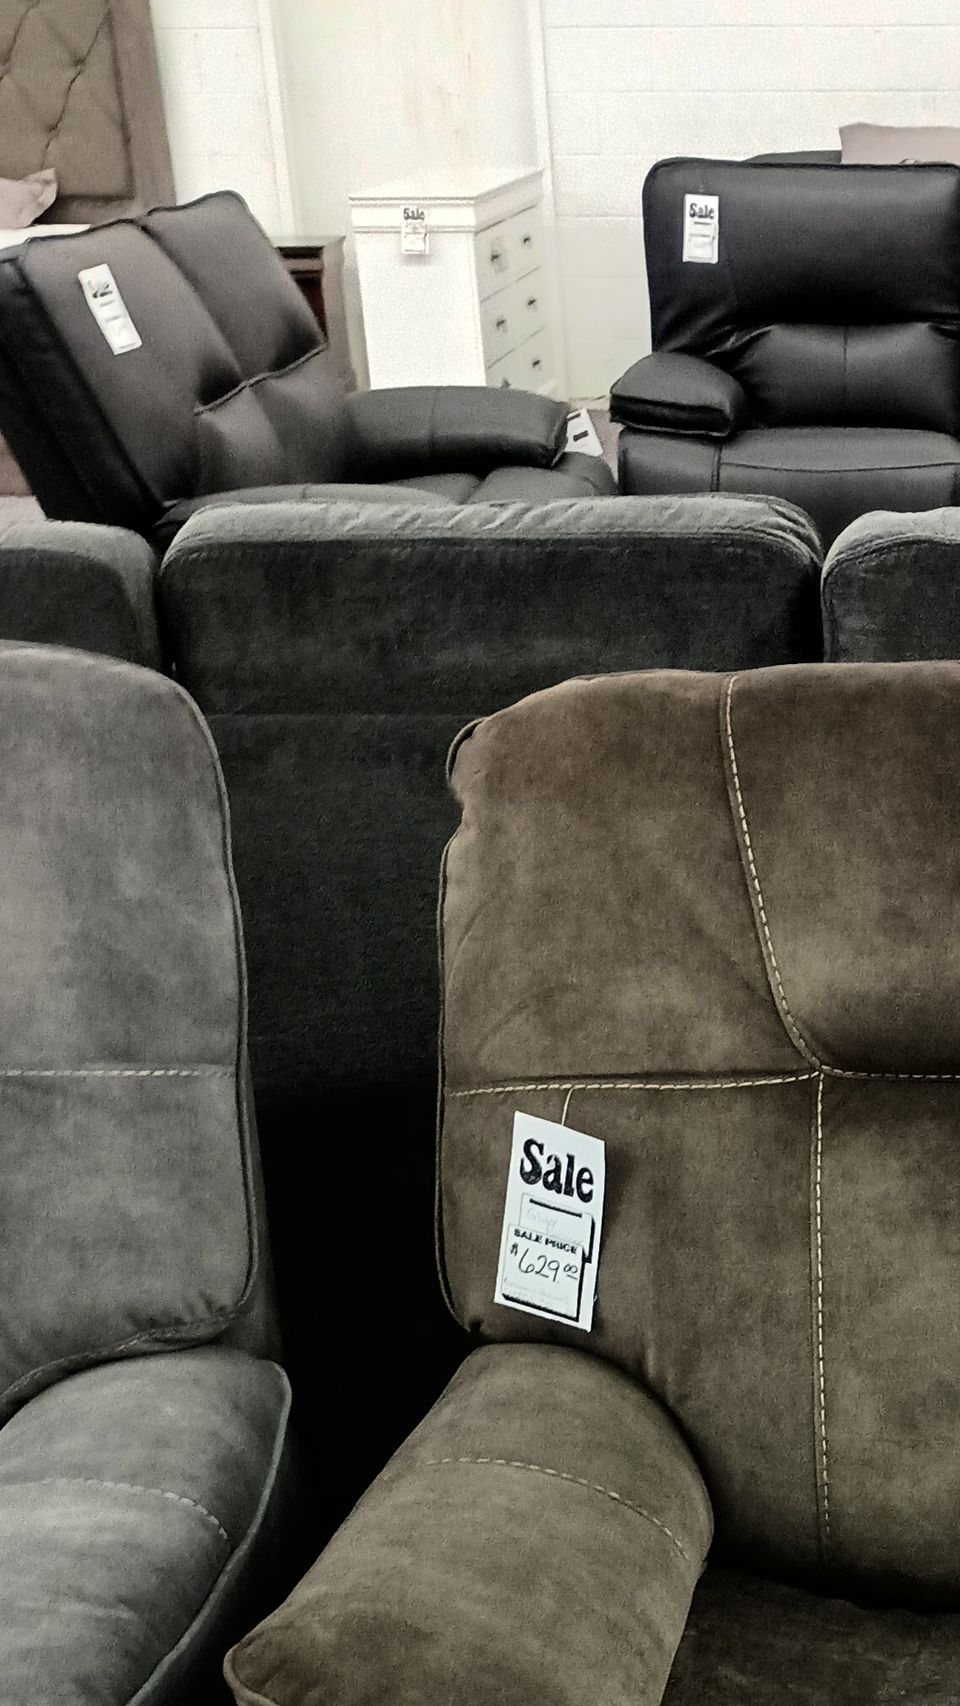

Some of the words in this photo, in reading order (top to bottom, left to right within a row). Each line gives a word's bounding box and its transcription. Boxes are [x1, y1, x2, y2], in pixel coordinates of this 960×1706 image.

[689, 202, 715, 219] Sale
[519, 1138, 594, 1203] Sale
[513, 1228, 543, 1244] SALE
[544, 1238, 578, 1254] PRICE
